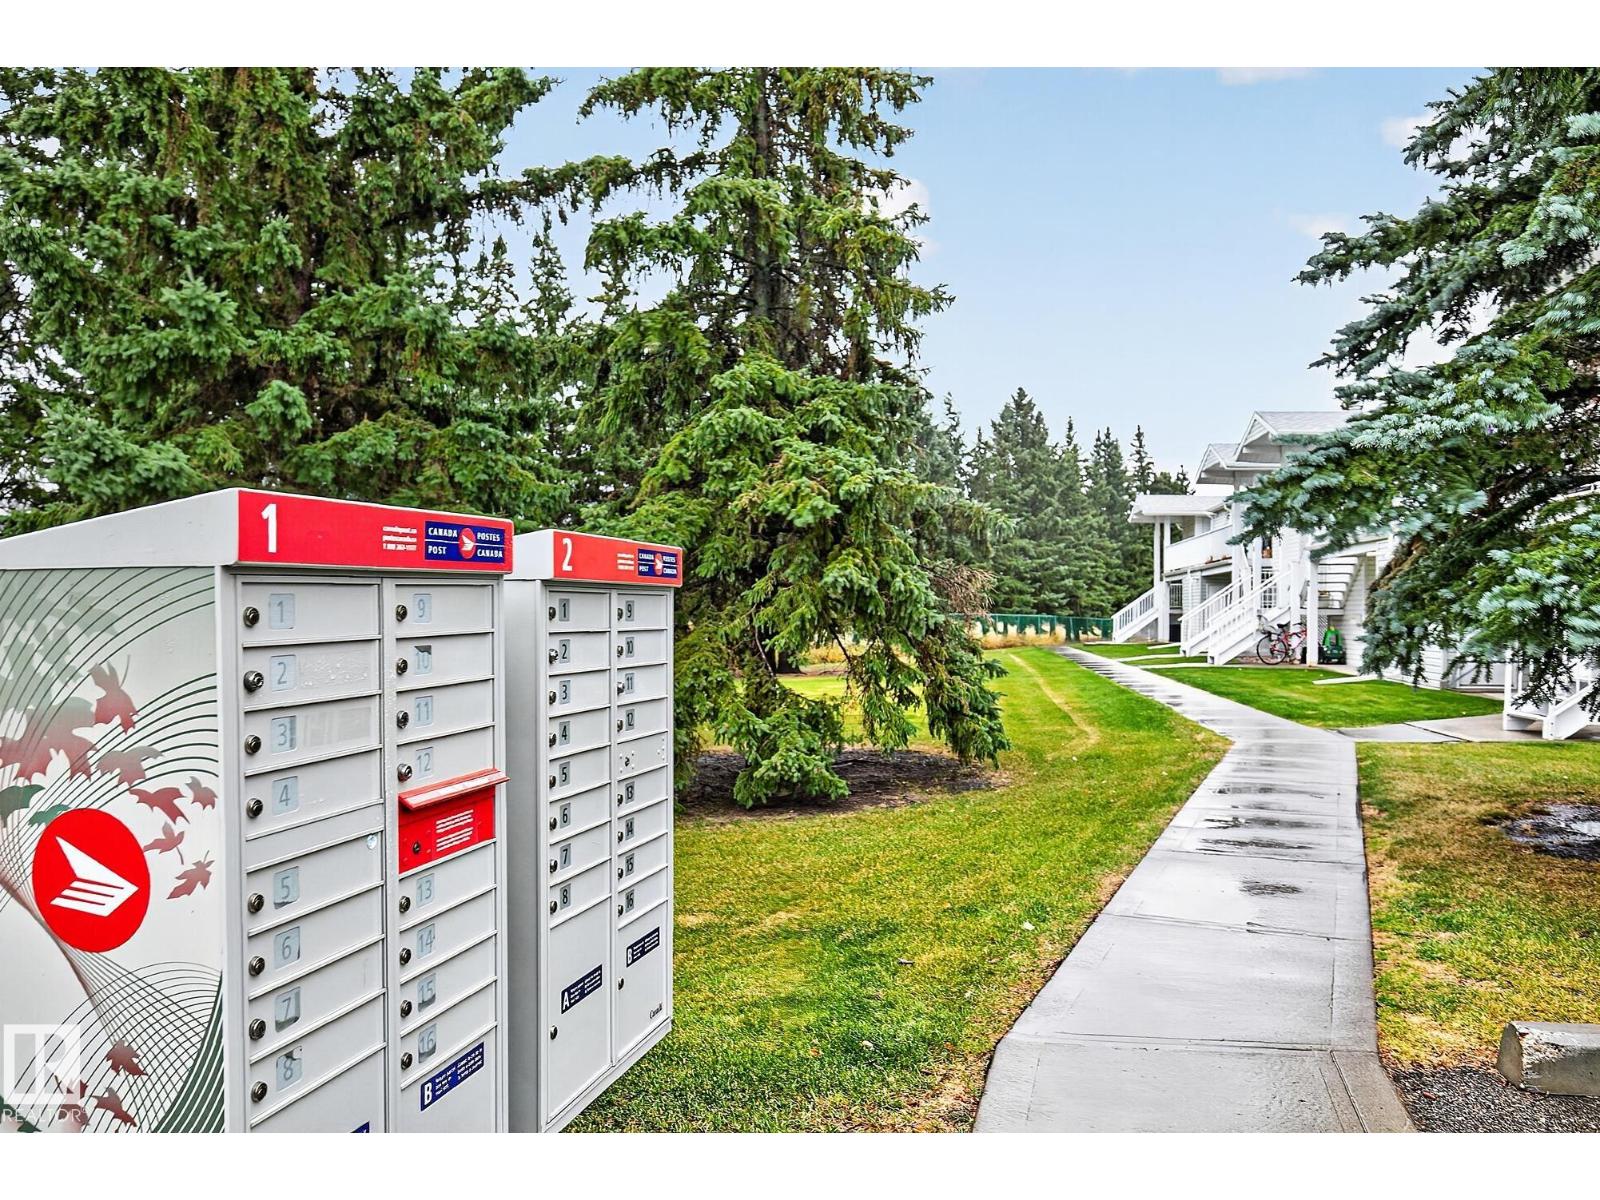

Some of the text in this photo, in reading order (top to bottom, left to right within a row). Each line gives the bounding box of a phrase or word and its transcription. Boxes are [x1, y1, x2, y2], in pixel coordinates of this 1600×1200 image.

[261, 503, 278, 553] 1
[428, 527, 458, 538] CANADA
[477, 532, 501, 542] POSTES
[428, 545, 447, 555] POST
[477, 548, 503, 558] CANADA
[562, 537, 573, 571] 2
[277, 600, 284, 623] 1
[417, 598, 426, 618] 9
[562, 602, 567, 619] 1
[627, 603, 633, 618] 9
[561, 643, 568, 660] 2
[626, 640, 634, 655] 10
[415, 651, 430, 670] 10
[277, 661, 288, 685] 2
[562, 684, 568, 700] 3
[626, 676, 633, 691] 11
[416, 701, 430, 721] 11
[626, 712, 634, 727] 12
[278, 723, 288, 746] 3
[561, 725, 567, 741] 4
[417, 752, 431, 774] 12
[561, 766, 567, 782] 5
[278, 783, 290, 807] 4
[562, 807, 568, 824] 6
[562, 848, 568, 865] 7
[281, 875, 290, 900] 5
[417, 880, 432, 902] 13
[562, 888, 568, 905] 8
[281, 936, 292, 960] 6
[419, 929, 434, 953] 14
[627, 948, 633, 965] B
[419, 980, 433, 1003] 15
[562, 991, 570, 1011] A
[281, 997, 292, 1019] 7
[419, 1031, 434, 1053] 16
[283, 1058, 294, 1081] 8
[423, 1082, 433, 1106] B
